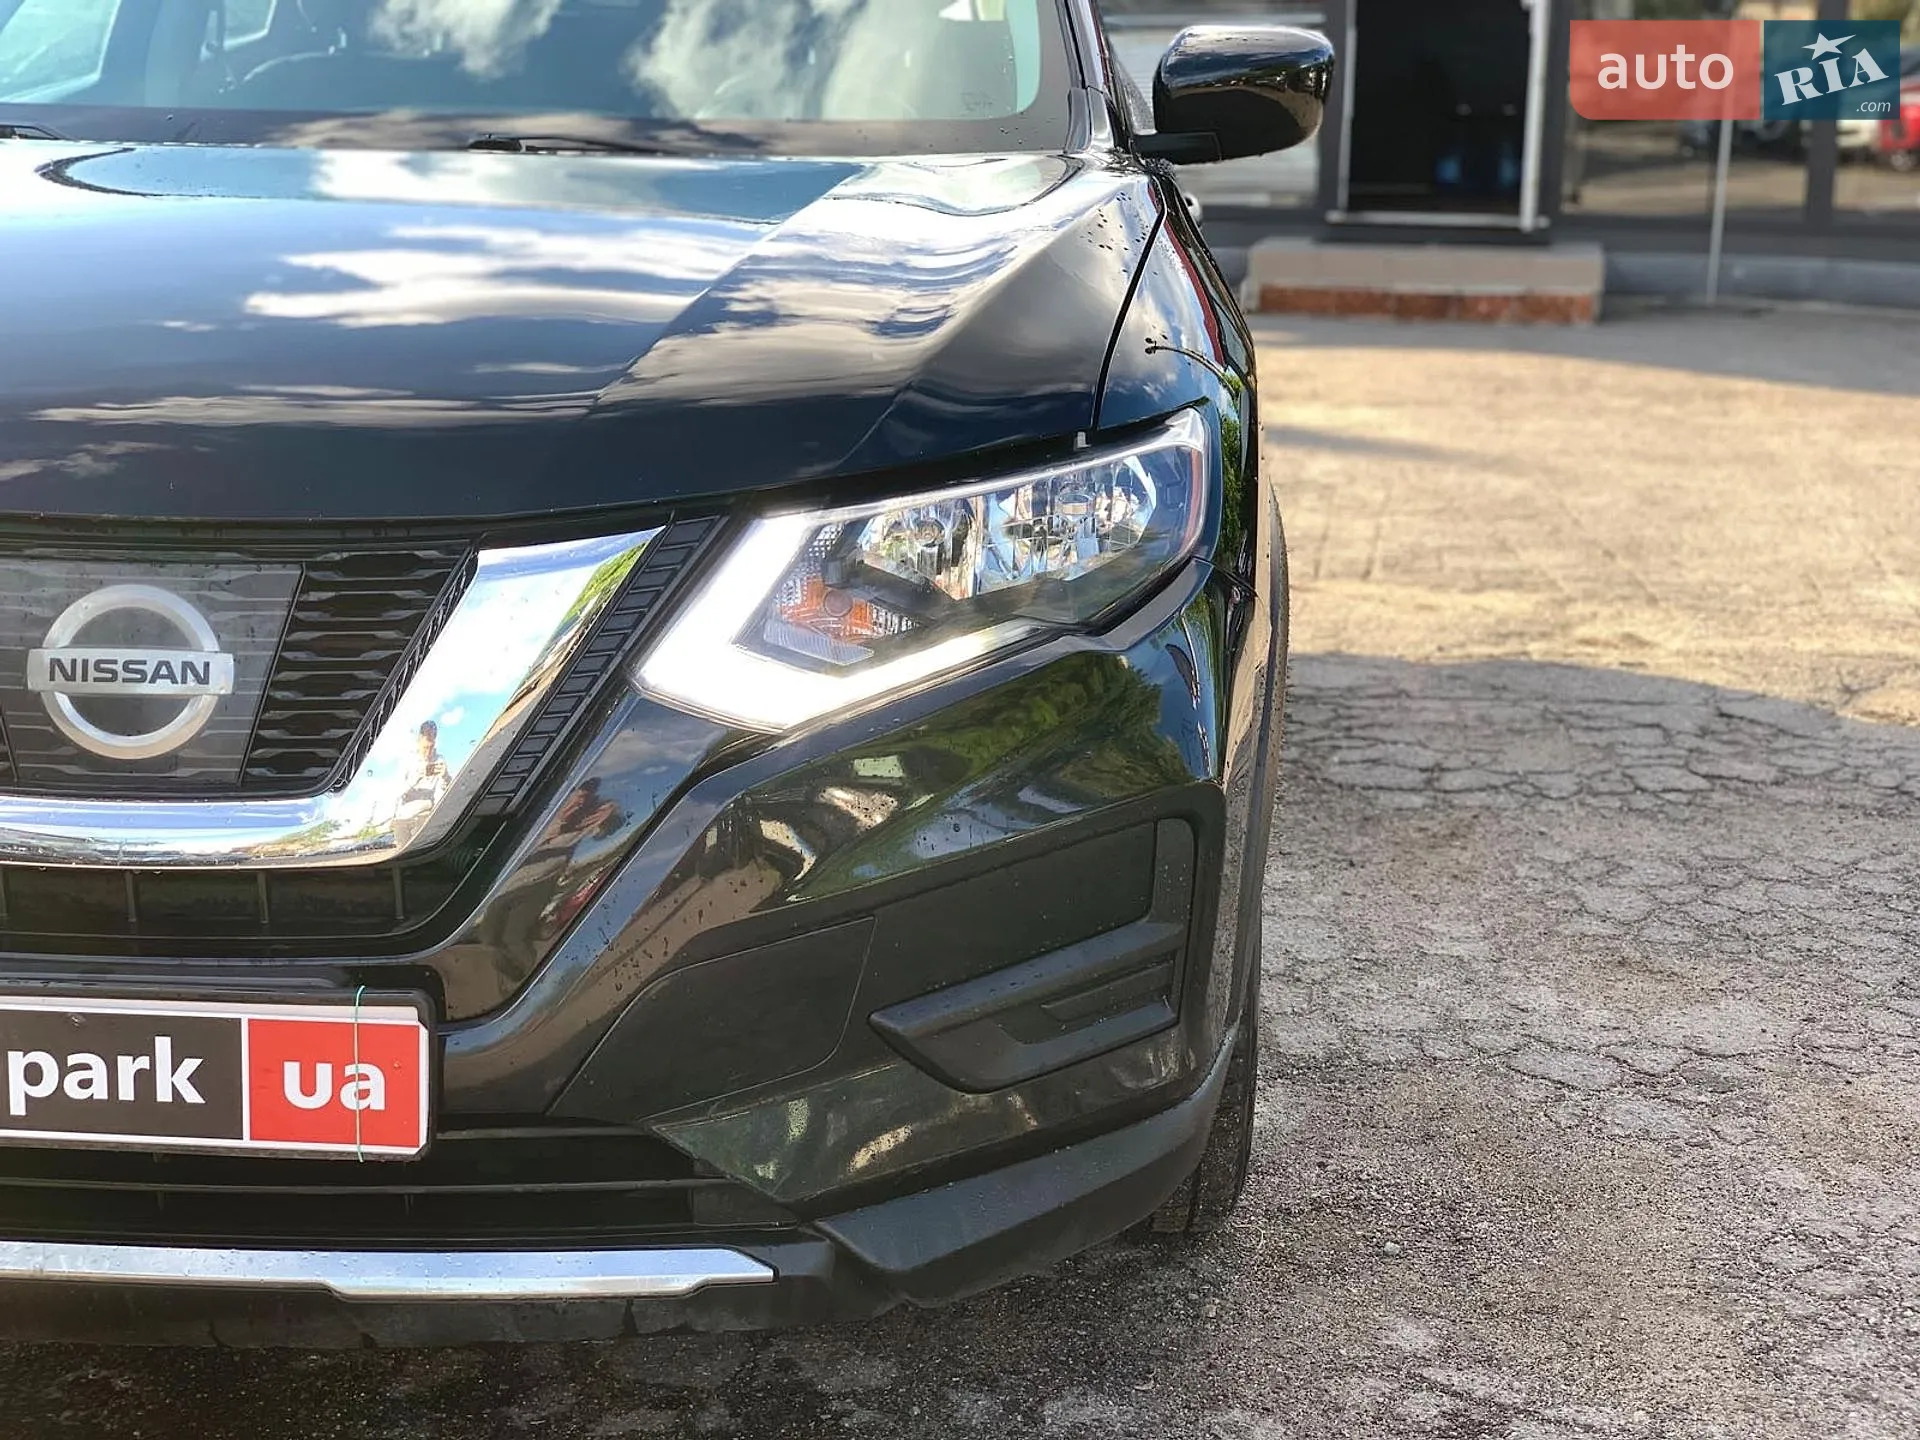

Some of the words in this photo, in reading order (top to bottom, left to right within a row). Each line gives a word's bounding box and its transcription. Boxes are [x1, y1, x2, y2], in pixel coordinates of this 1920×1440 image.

[49, 657, 210, 685] NISSAN
[7, 1036, 206, 1116] park
[283, 1061, 386, 1111] ua
